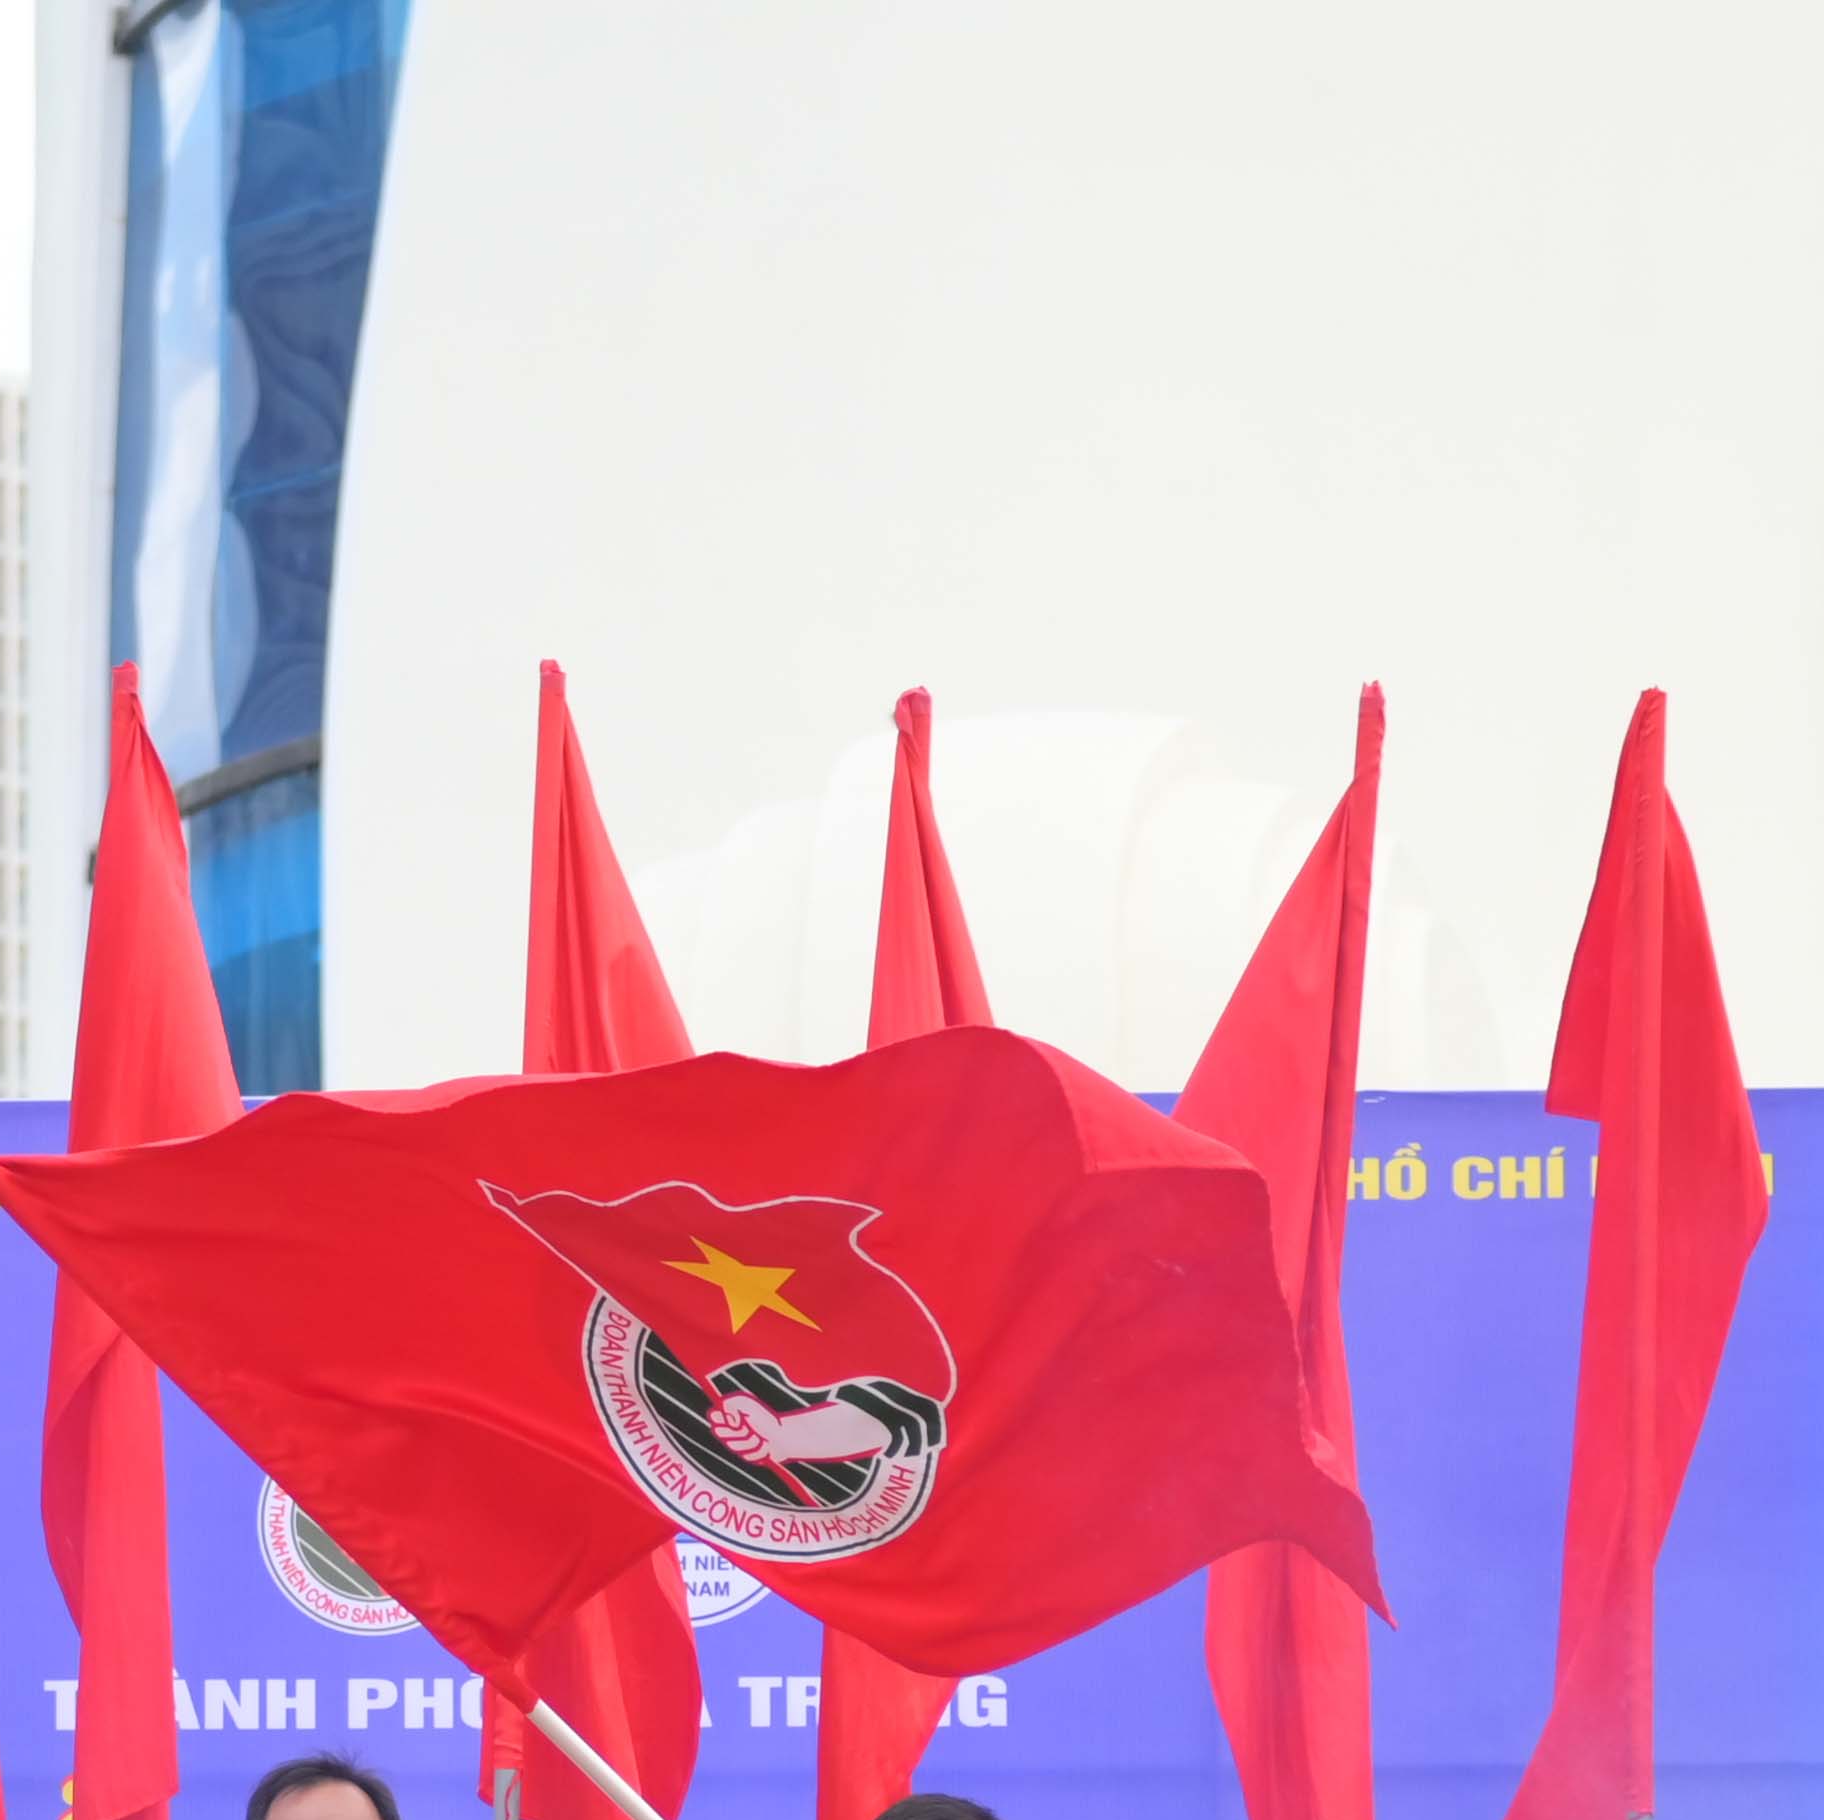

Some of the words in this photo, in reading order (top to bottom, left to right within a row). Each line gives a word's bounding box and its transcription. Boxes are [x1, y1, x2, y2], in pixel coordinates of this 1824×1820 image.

[1348, 1143, 1428, 1200] HỒ
[1452, 1146, 1565, 1200] CHÍ
[640, 1443, 698, 1501] NIÊN
[691, 1489, 765, 1539] CỘNG
[879, 1464, 917, 1515] MINH
